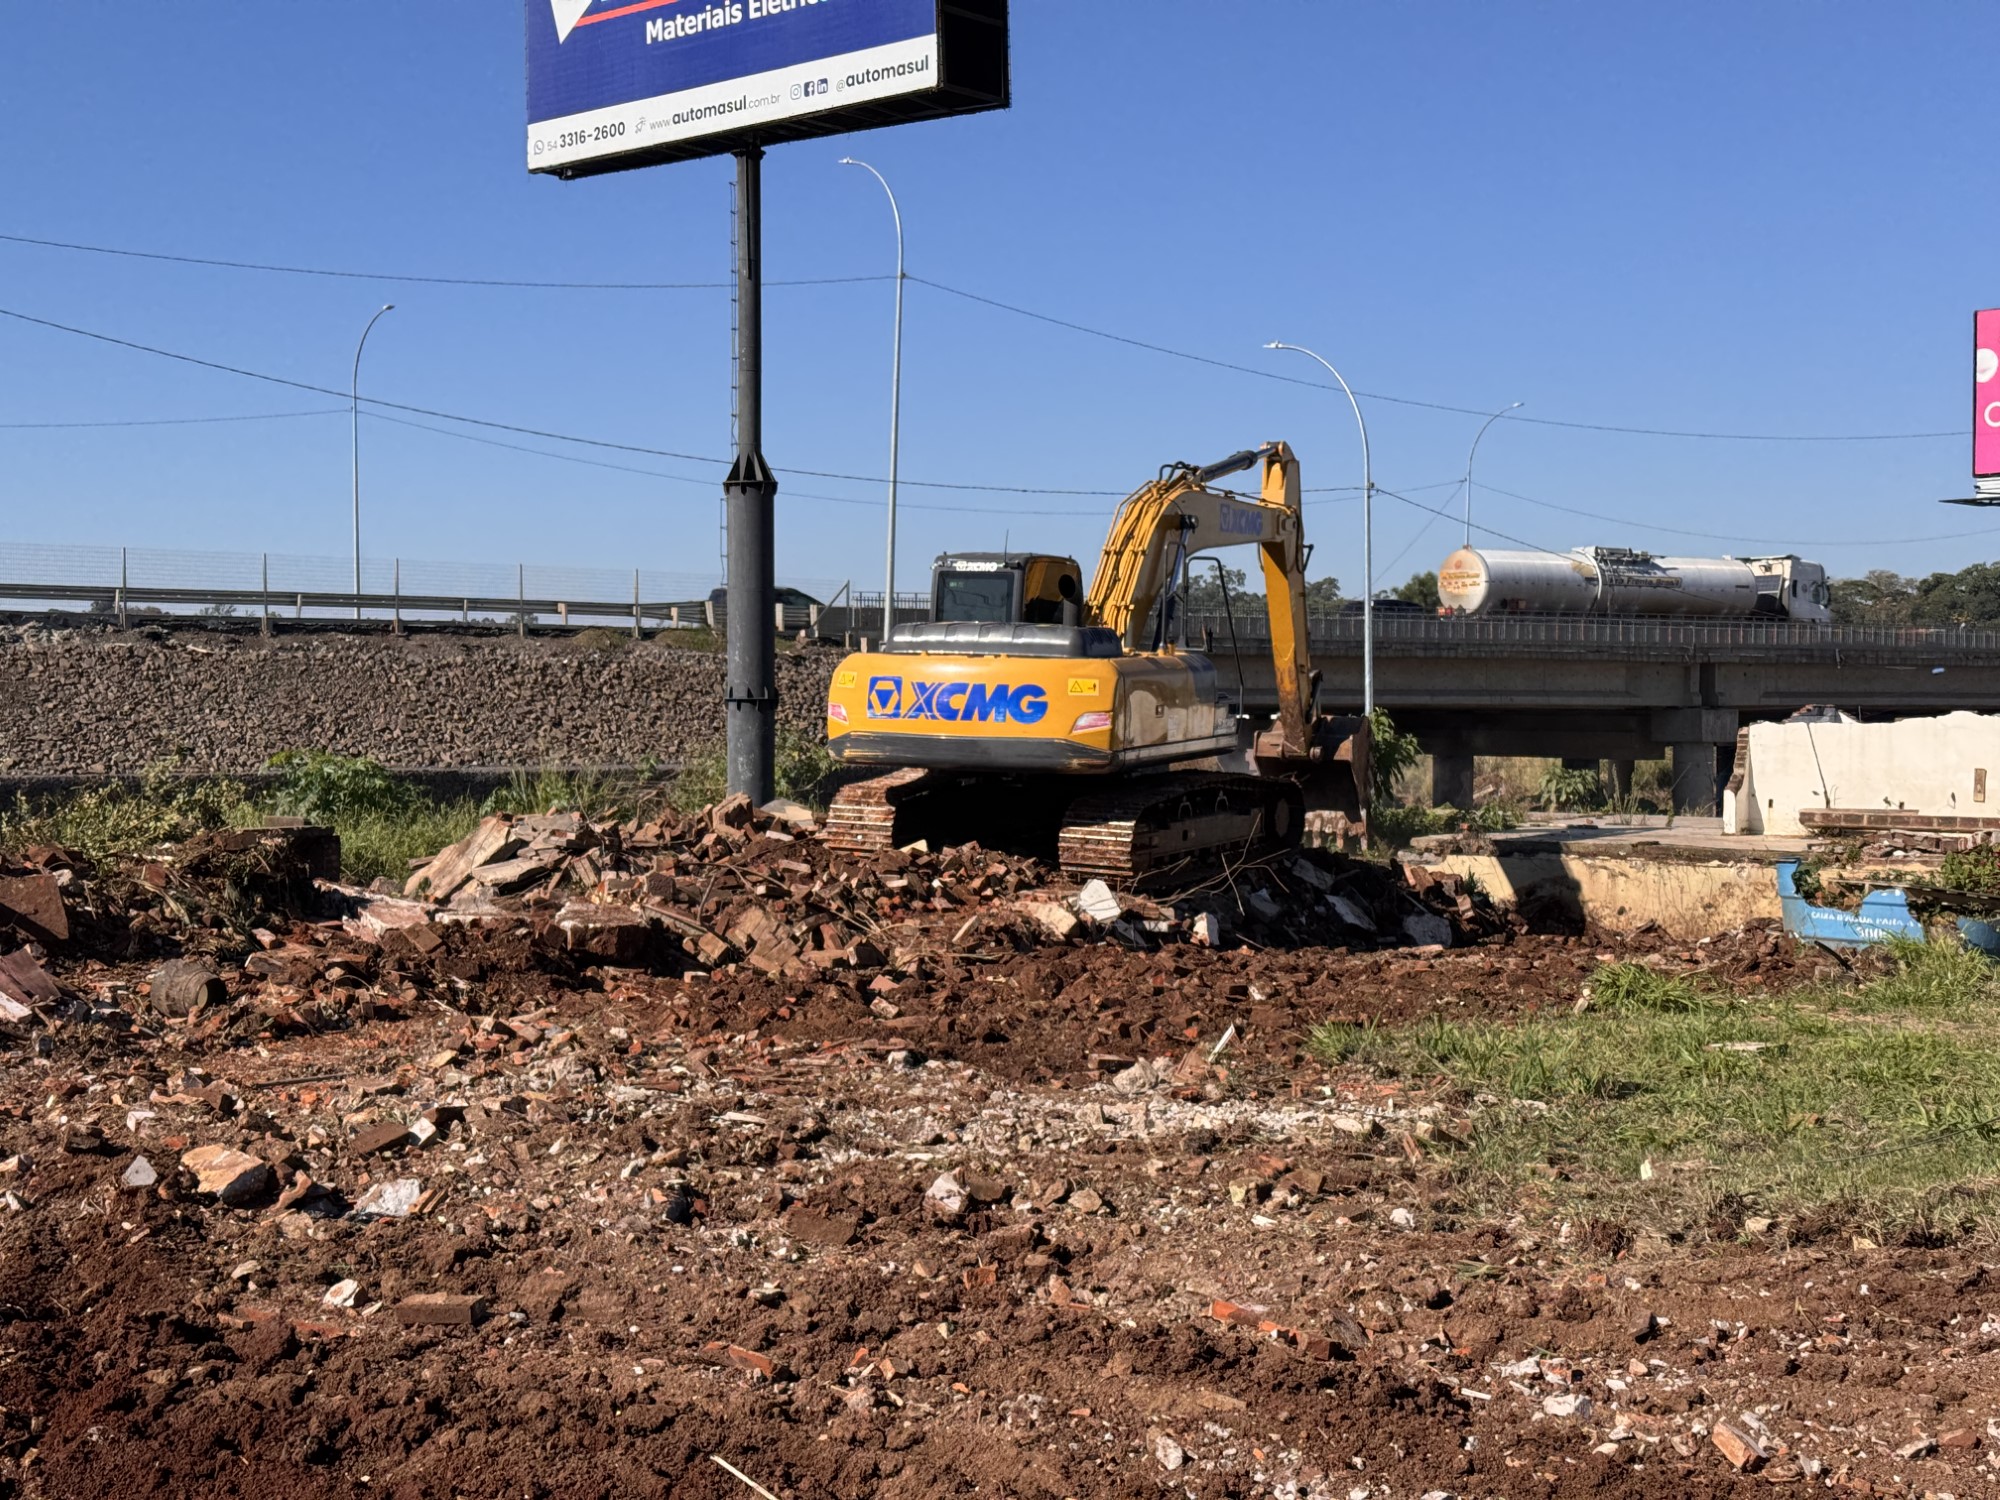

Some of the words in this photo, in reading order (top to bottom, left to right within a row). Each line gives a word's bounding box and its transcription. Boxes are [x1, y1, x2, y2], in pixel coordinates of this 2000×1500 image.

[645, 0, 743, 45] Materiais
[547, 141, 558, 152] 54
[559, 121, 626, 149] 3316-2600
[650, 93, 781, 131] www.automasul.com.br
[836, 54, 930, 93] @automasul
[903, 681, 1049, 725] XCMG
